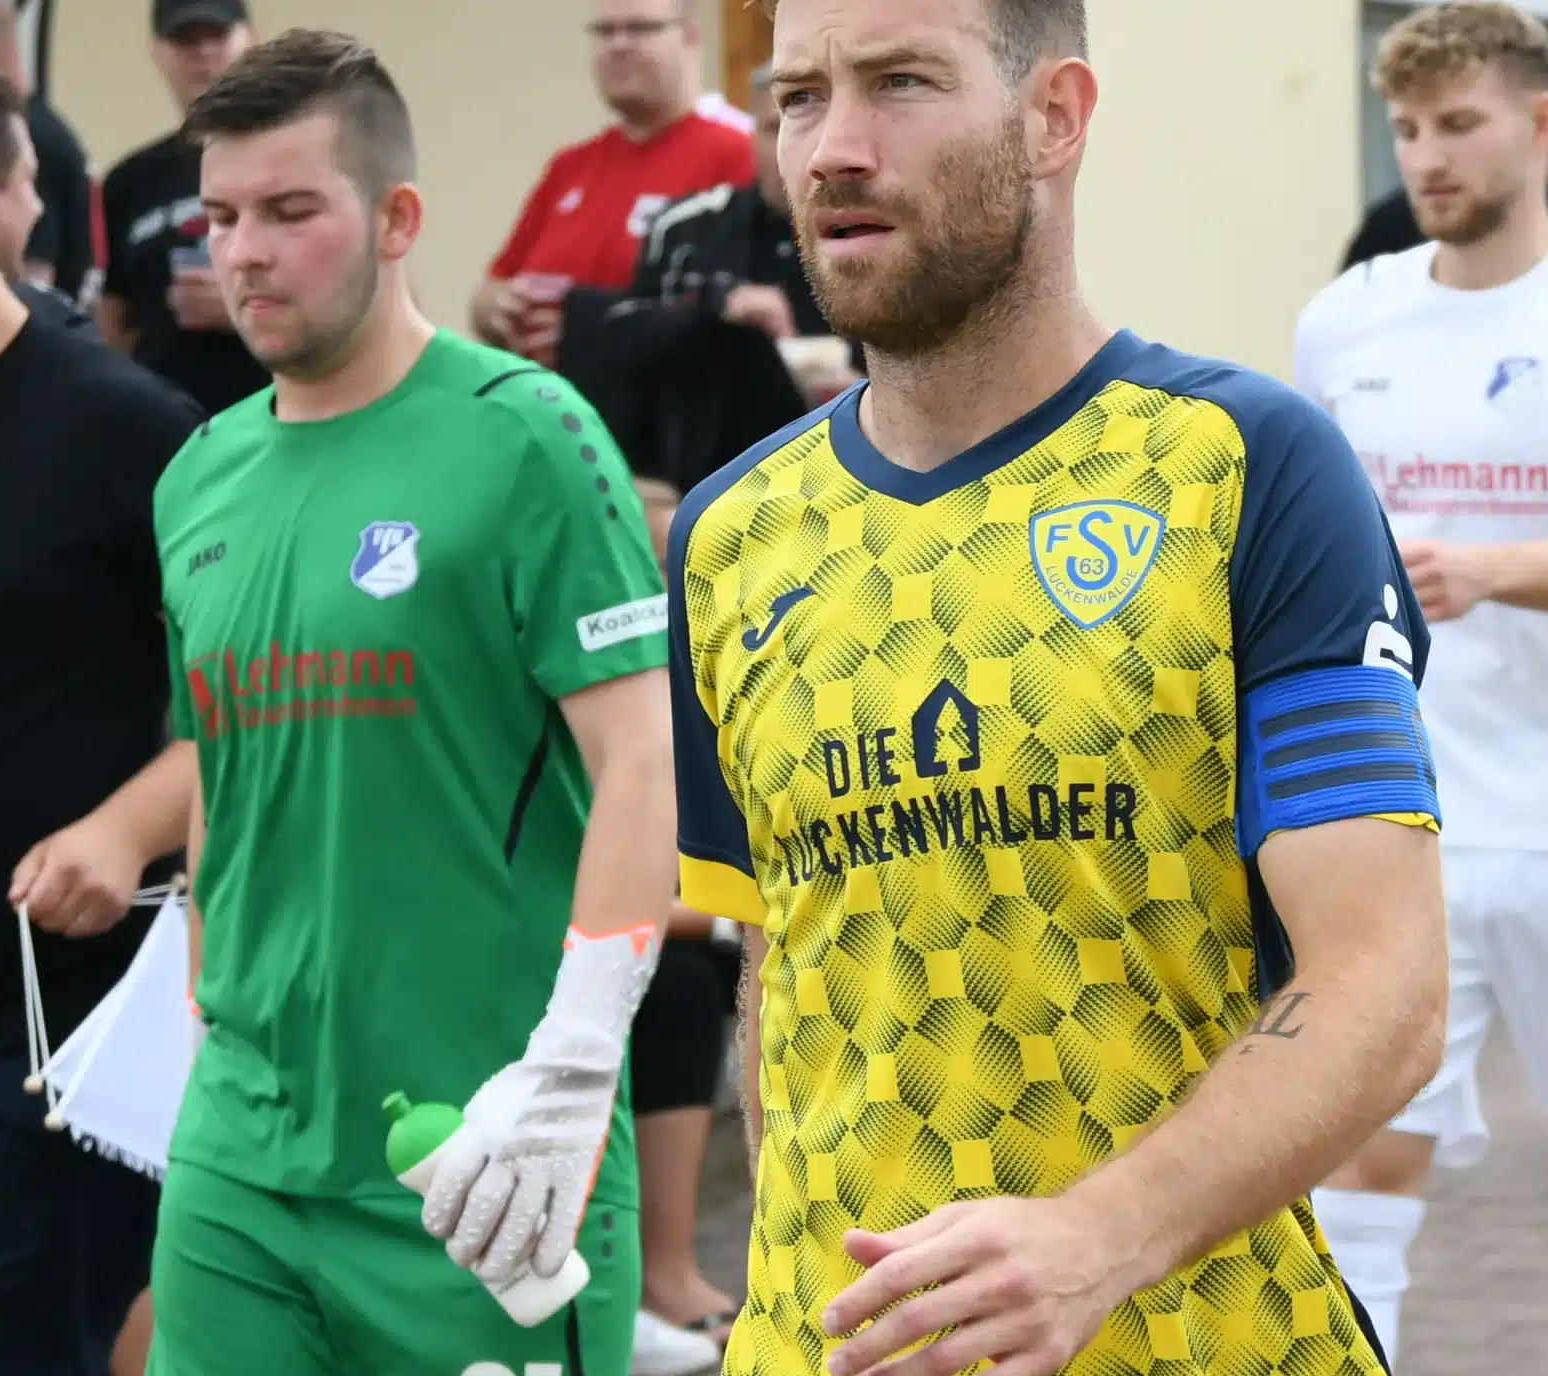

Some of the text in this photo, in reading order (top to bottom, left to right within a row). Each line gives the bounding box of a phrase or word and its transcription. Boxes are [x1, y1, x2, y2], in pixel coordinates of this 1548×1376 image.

[1046, 510, 1150, 590] FSV
[1079, 557, 1105, 575] 63
[1046, 565, 1138, 605] LUCKENWALDE
[823, 726, 901, 799] DIE
